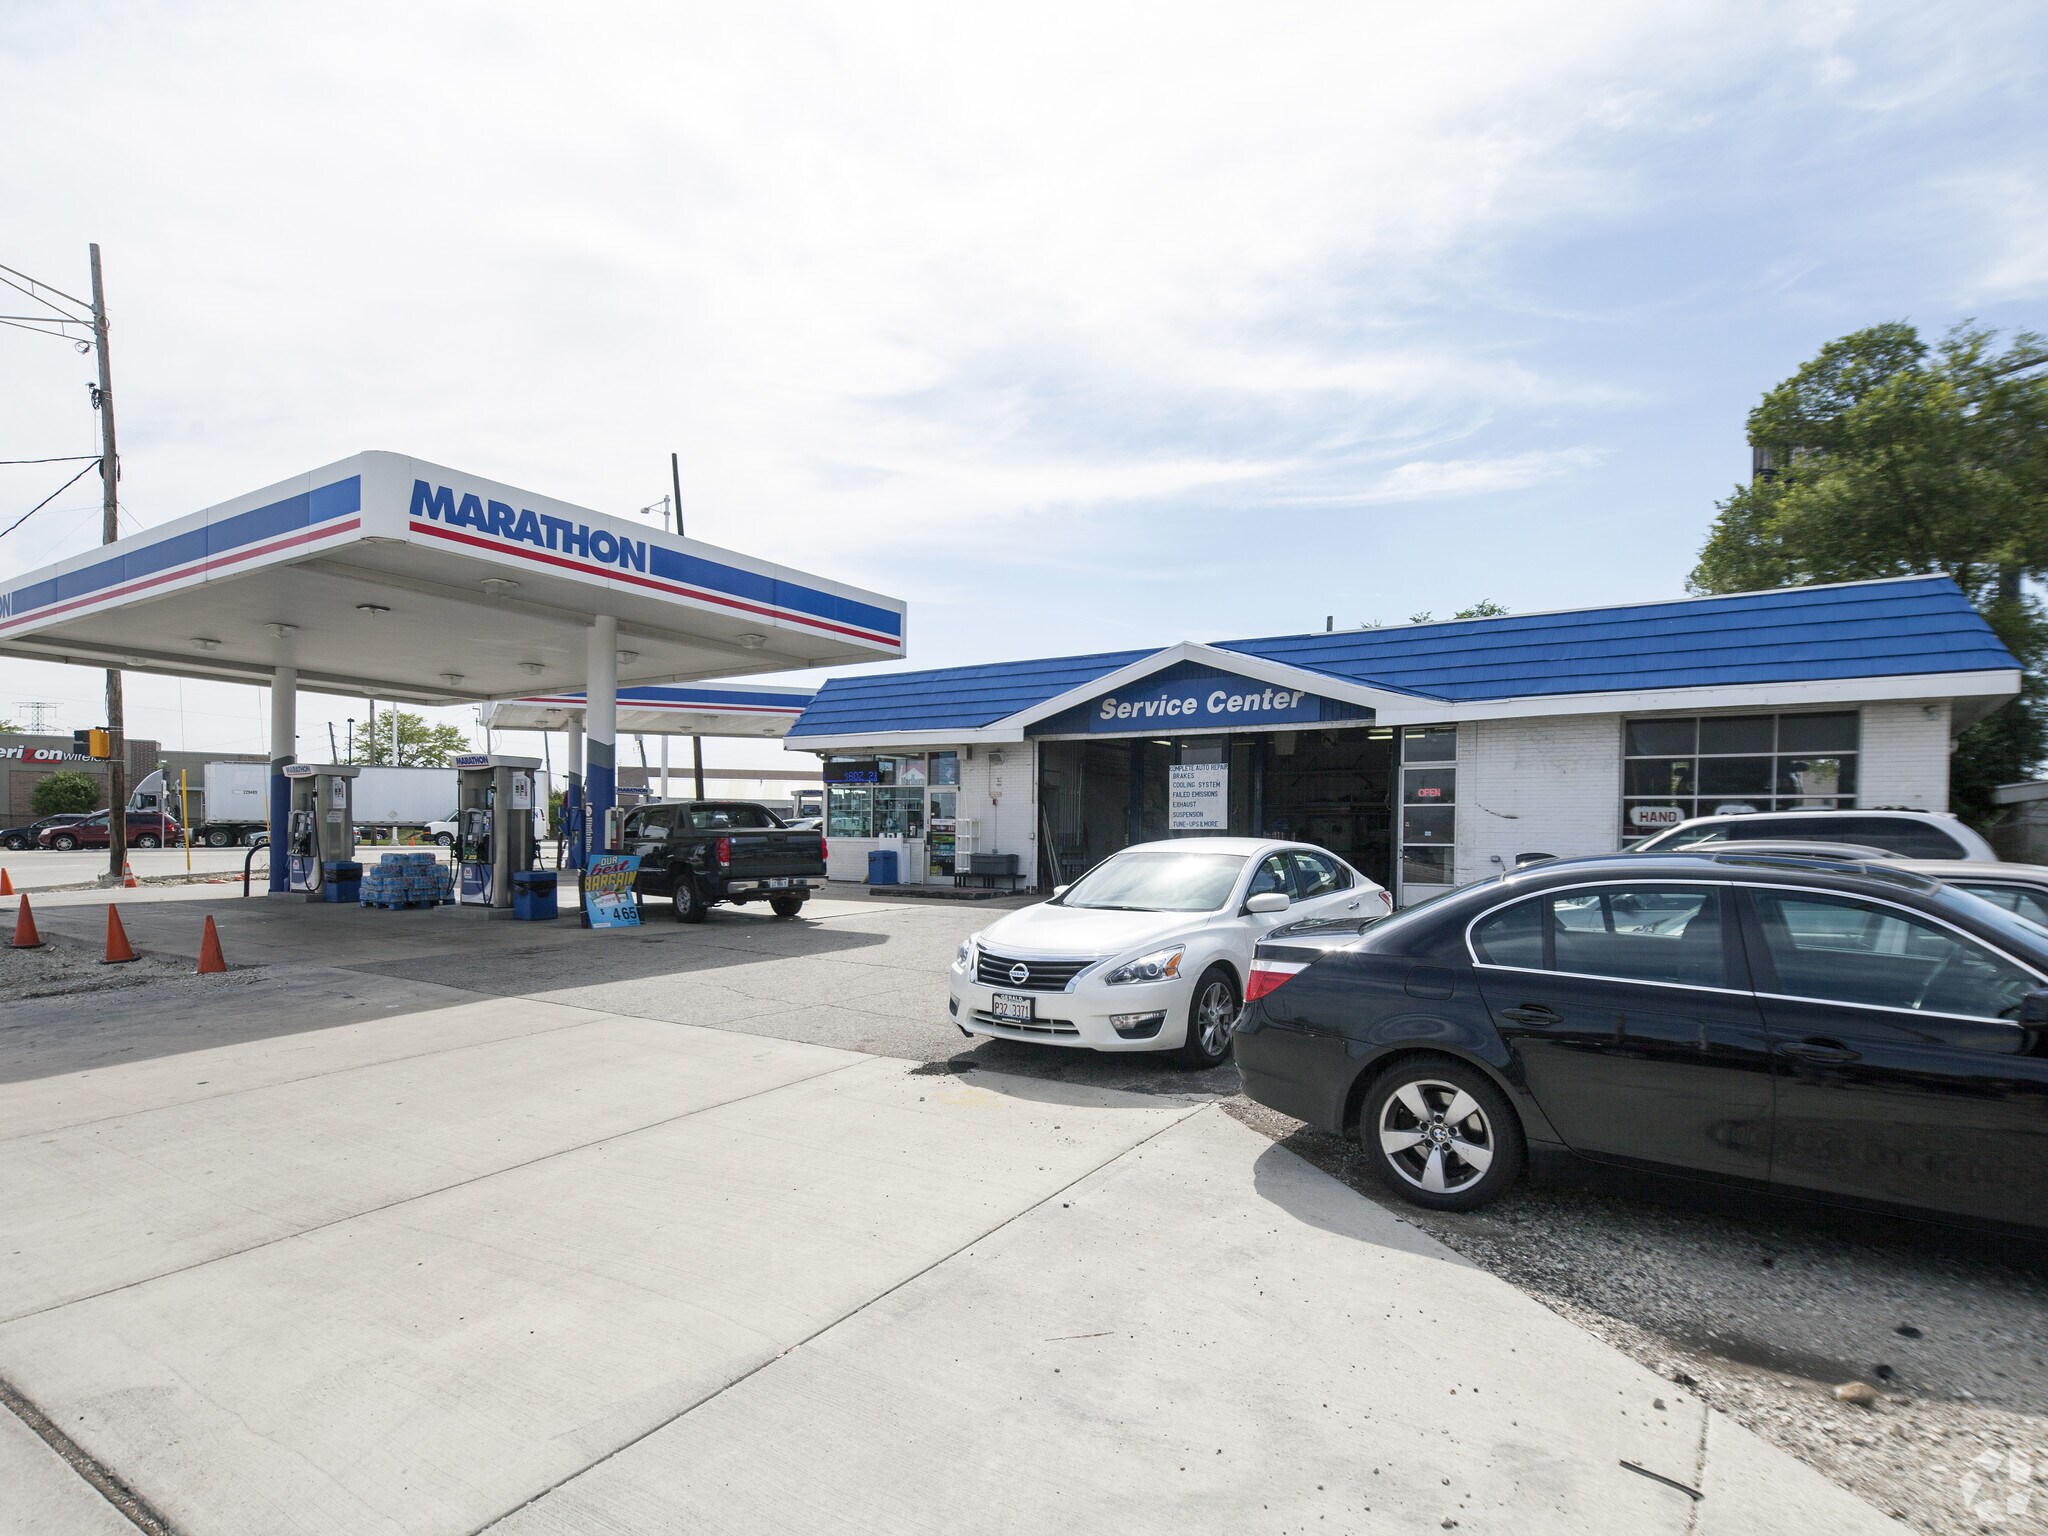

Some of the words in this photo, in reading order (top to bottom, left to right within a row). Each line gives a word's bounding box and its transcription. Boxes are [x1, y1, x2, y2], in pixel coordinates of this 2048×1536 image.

[410, 479, 646, 573] MARATHON
[1100, 694, 1198, 720] Service
[1206, 688, 1305, 714] Center
[456, 755, 489, 765] MARATHON
[1418, 788, 1441, 797] OPEN
[1640, 811, 1677, 823] HAND
[590, 860, 630, 876] best
[600, 855, 618, 866] OUR
[584, 870, 638, 892] BARGAIN
[994, 1002, 1008, 1015] P32
[1012, 1004, 1030, 1019] 3371
